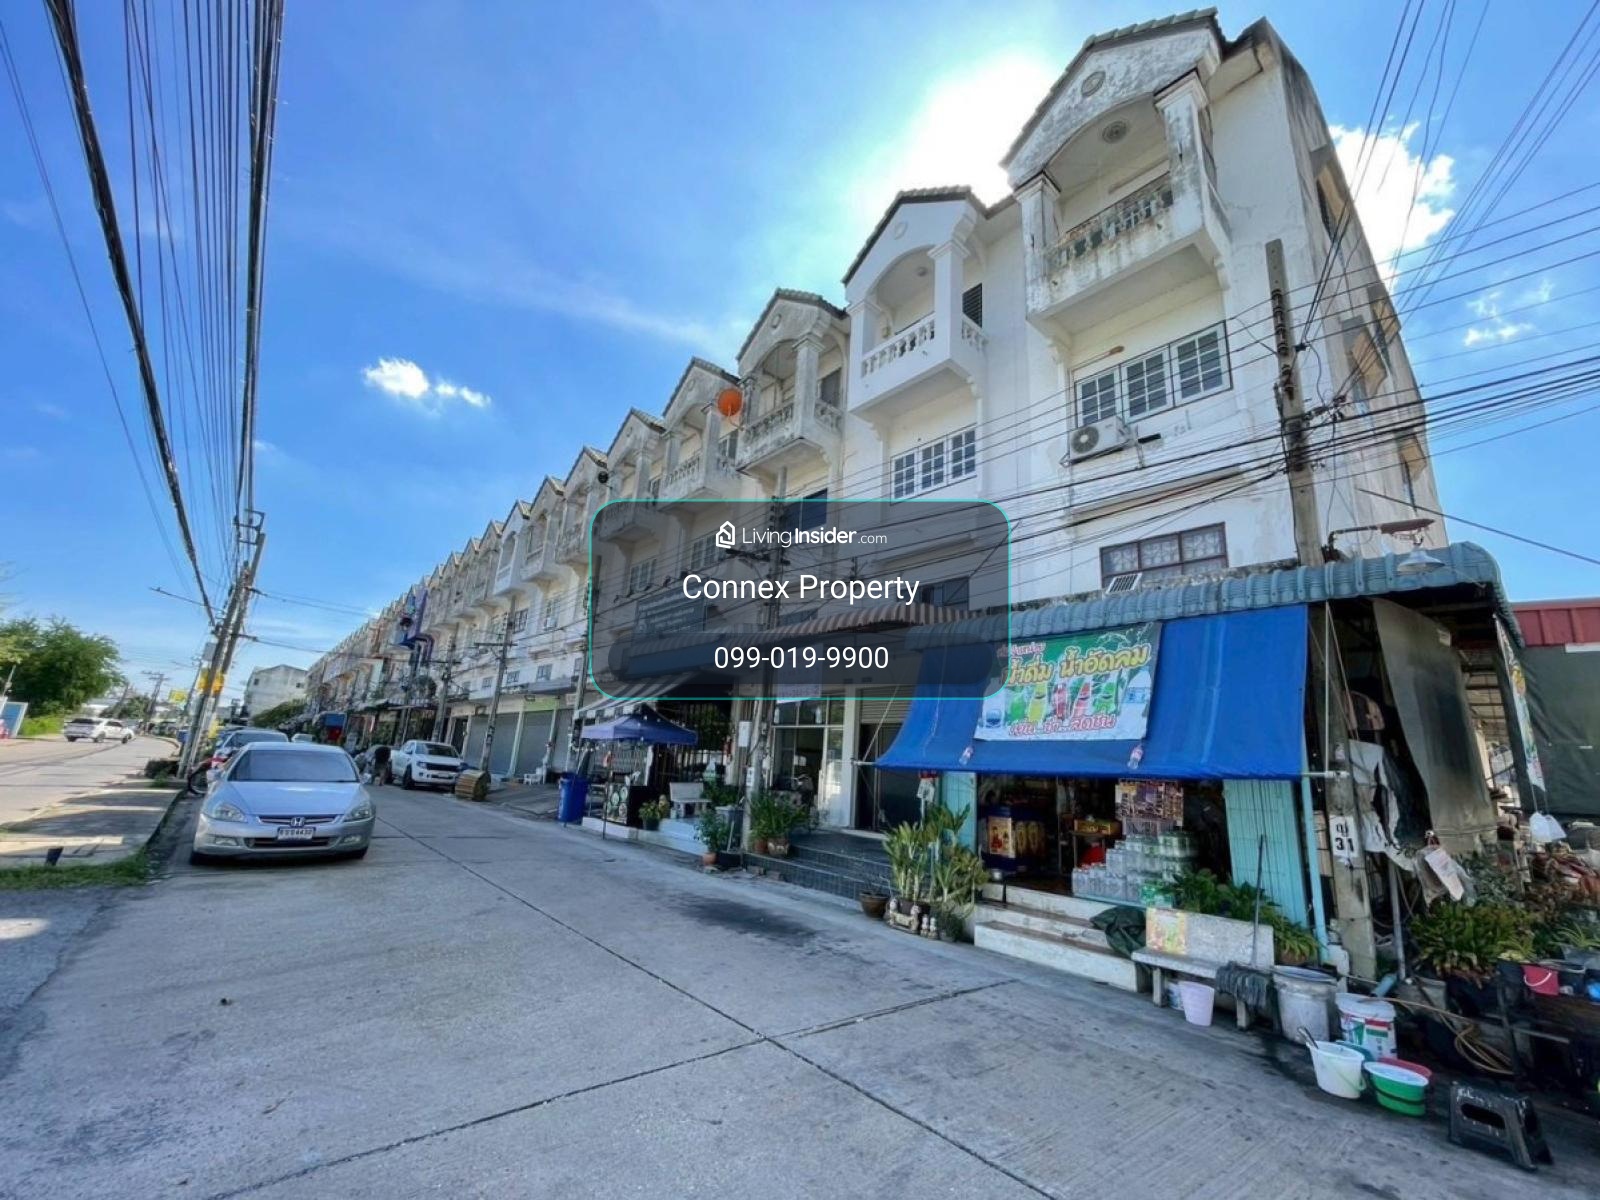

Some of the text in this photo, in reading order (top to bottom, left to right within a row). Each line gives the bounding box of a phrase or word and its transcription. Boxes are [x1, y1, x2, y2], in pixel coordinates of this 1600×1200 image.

[1059, 645, 1150, 677] น้ำอัดลม
[1334, 837, 1354, 852] 31
